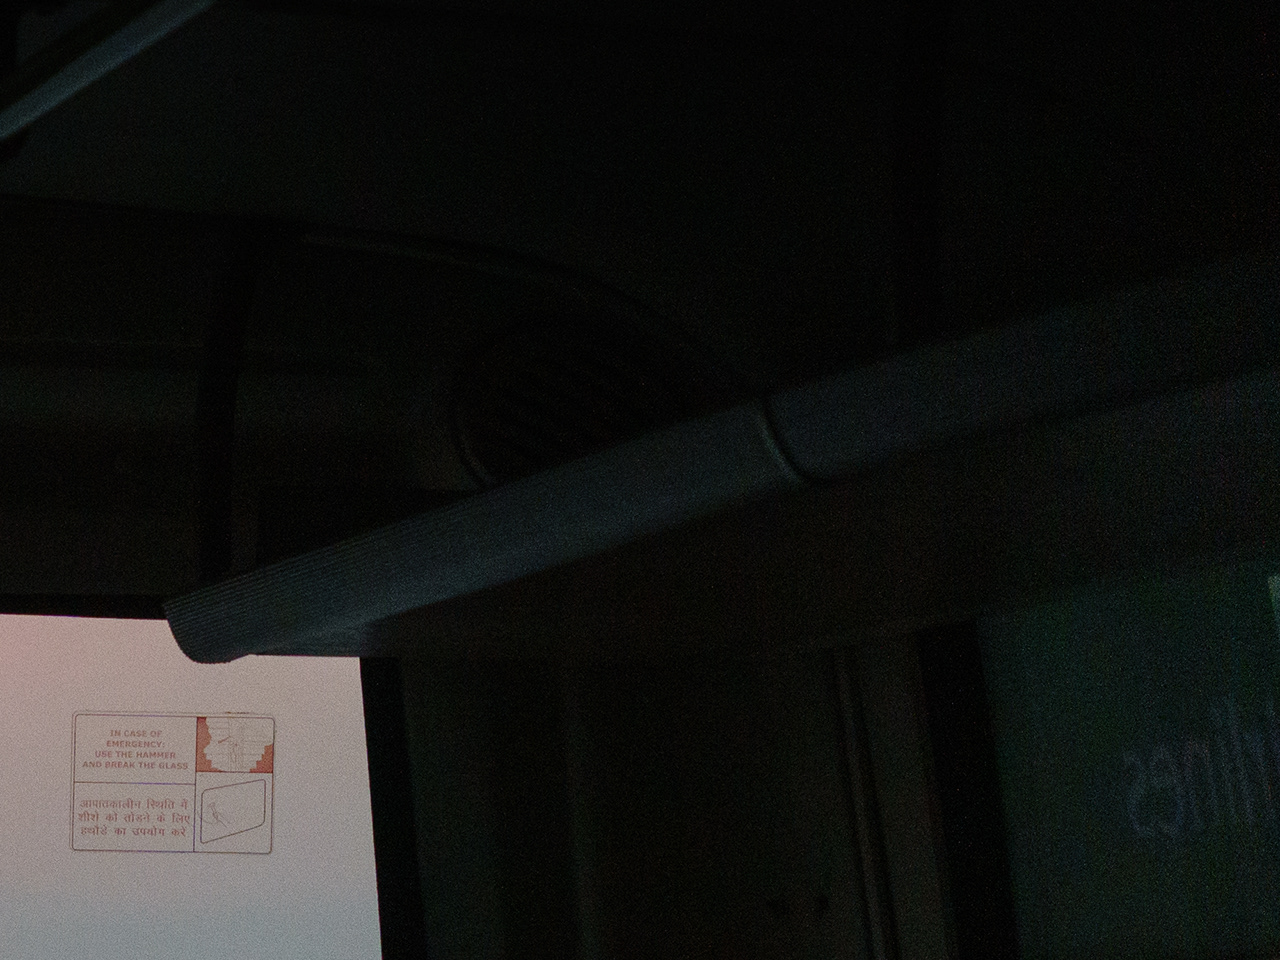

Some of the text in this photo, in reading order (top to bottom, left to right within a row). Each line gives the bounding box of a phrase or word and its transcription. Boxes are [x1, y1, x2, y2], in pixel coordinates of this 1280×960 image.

[110, 729, 163, 738] IN CASE OF
[95, 750, 176, 760] USE THE HAMMER
[82, 761, 188, 771] AND BREAK THE GLASS
[78, 810, 99, 822] शीशे
[105, 811, 118, 822] को
[156, 812, 166, 822] के
[172, 812, 190, 824] लिए
[115, 827, 126, 836] का
[132, 825, 164, 837] उपयोग
